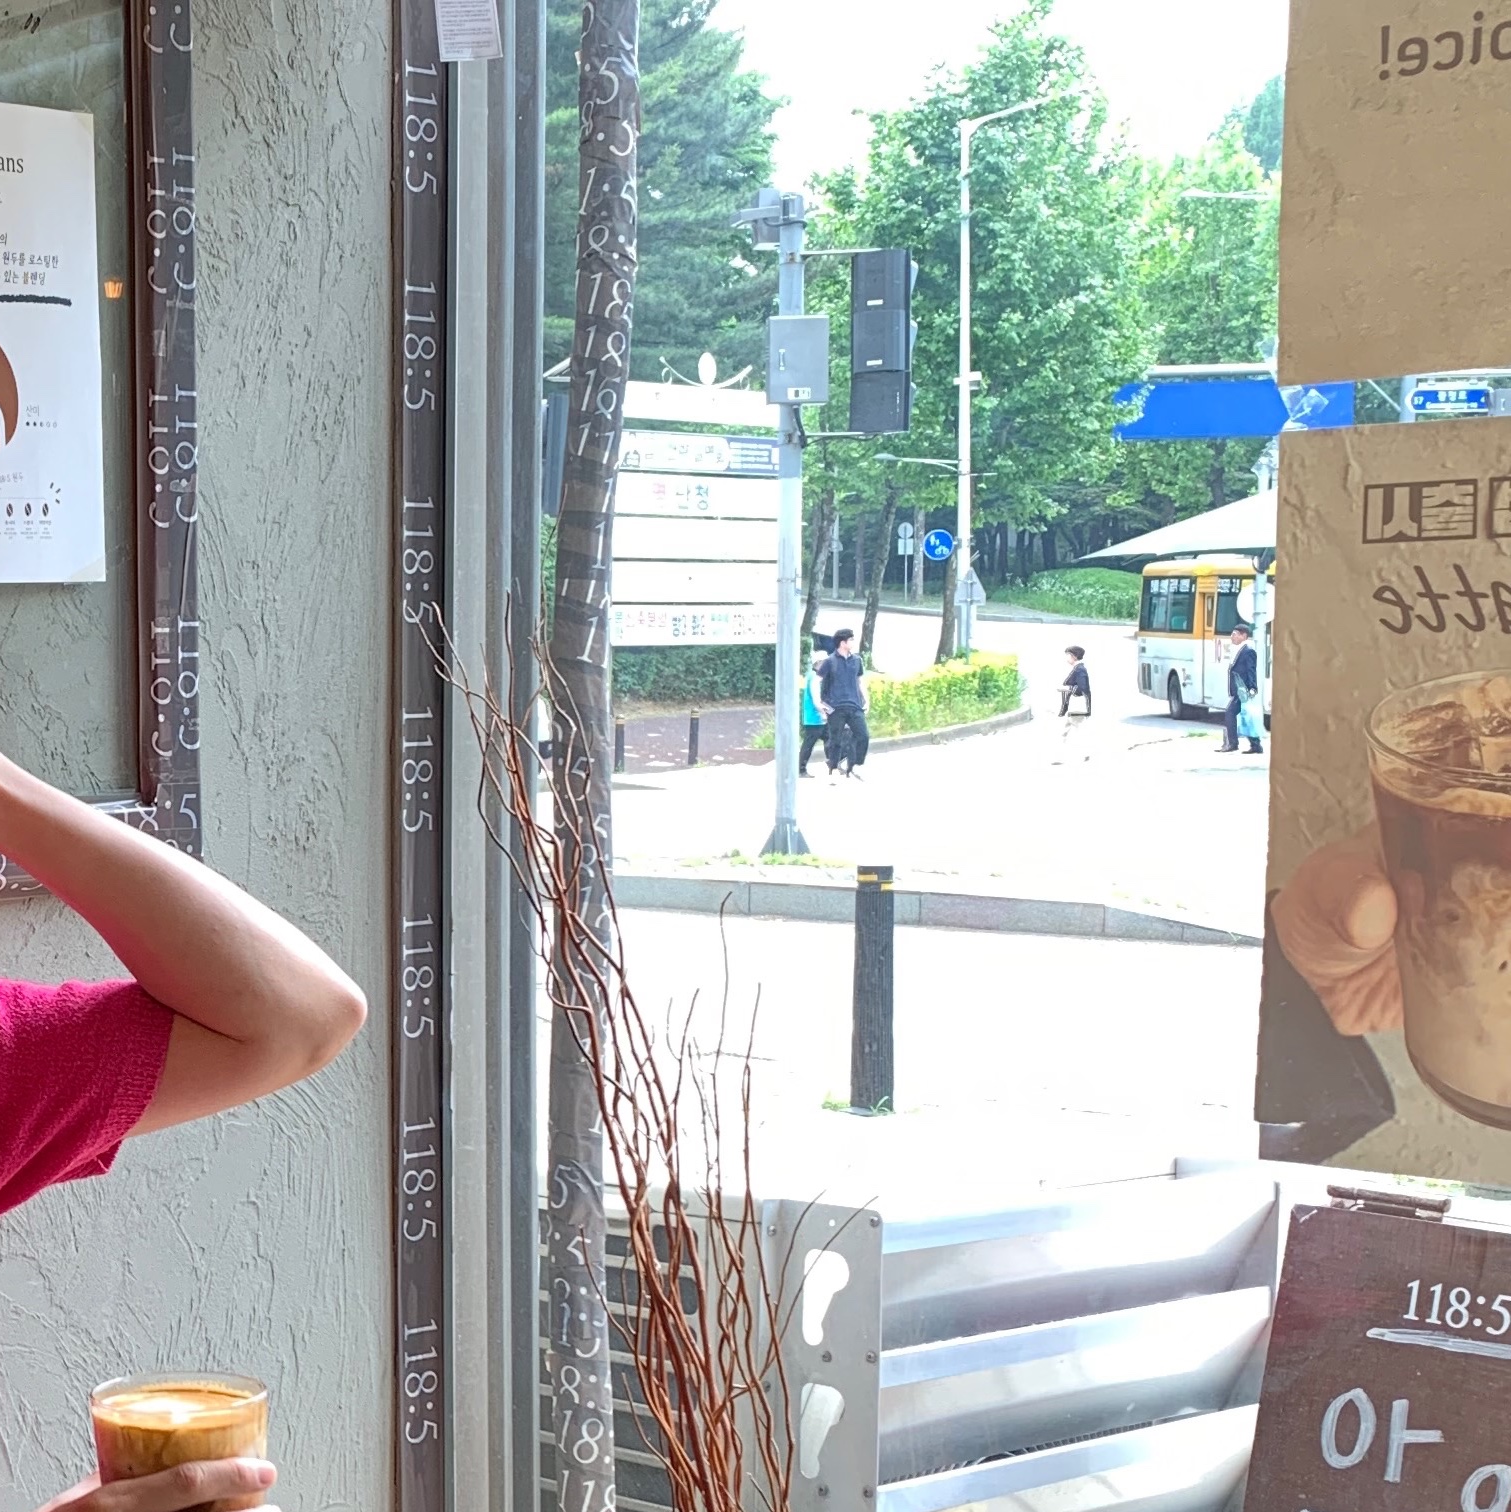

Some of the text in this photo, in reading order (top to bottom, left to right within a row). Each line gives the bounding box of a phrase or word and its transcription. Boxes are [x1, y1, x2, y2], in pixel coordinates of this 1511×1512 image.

[401, 60, 438, 196] 118:5
[402, 280, 437, 412] 118:5
[401, 915, 436, 1040] 118:5
[401, 1117, 437, 1243] 118:5
[1402, 1279, 1511, 1336] 118:5
[402, 1319, 438, 1445] 118:5
